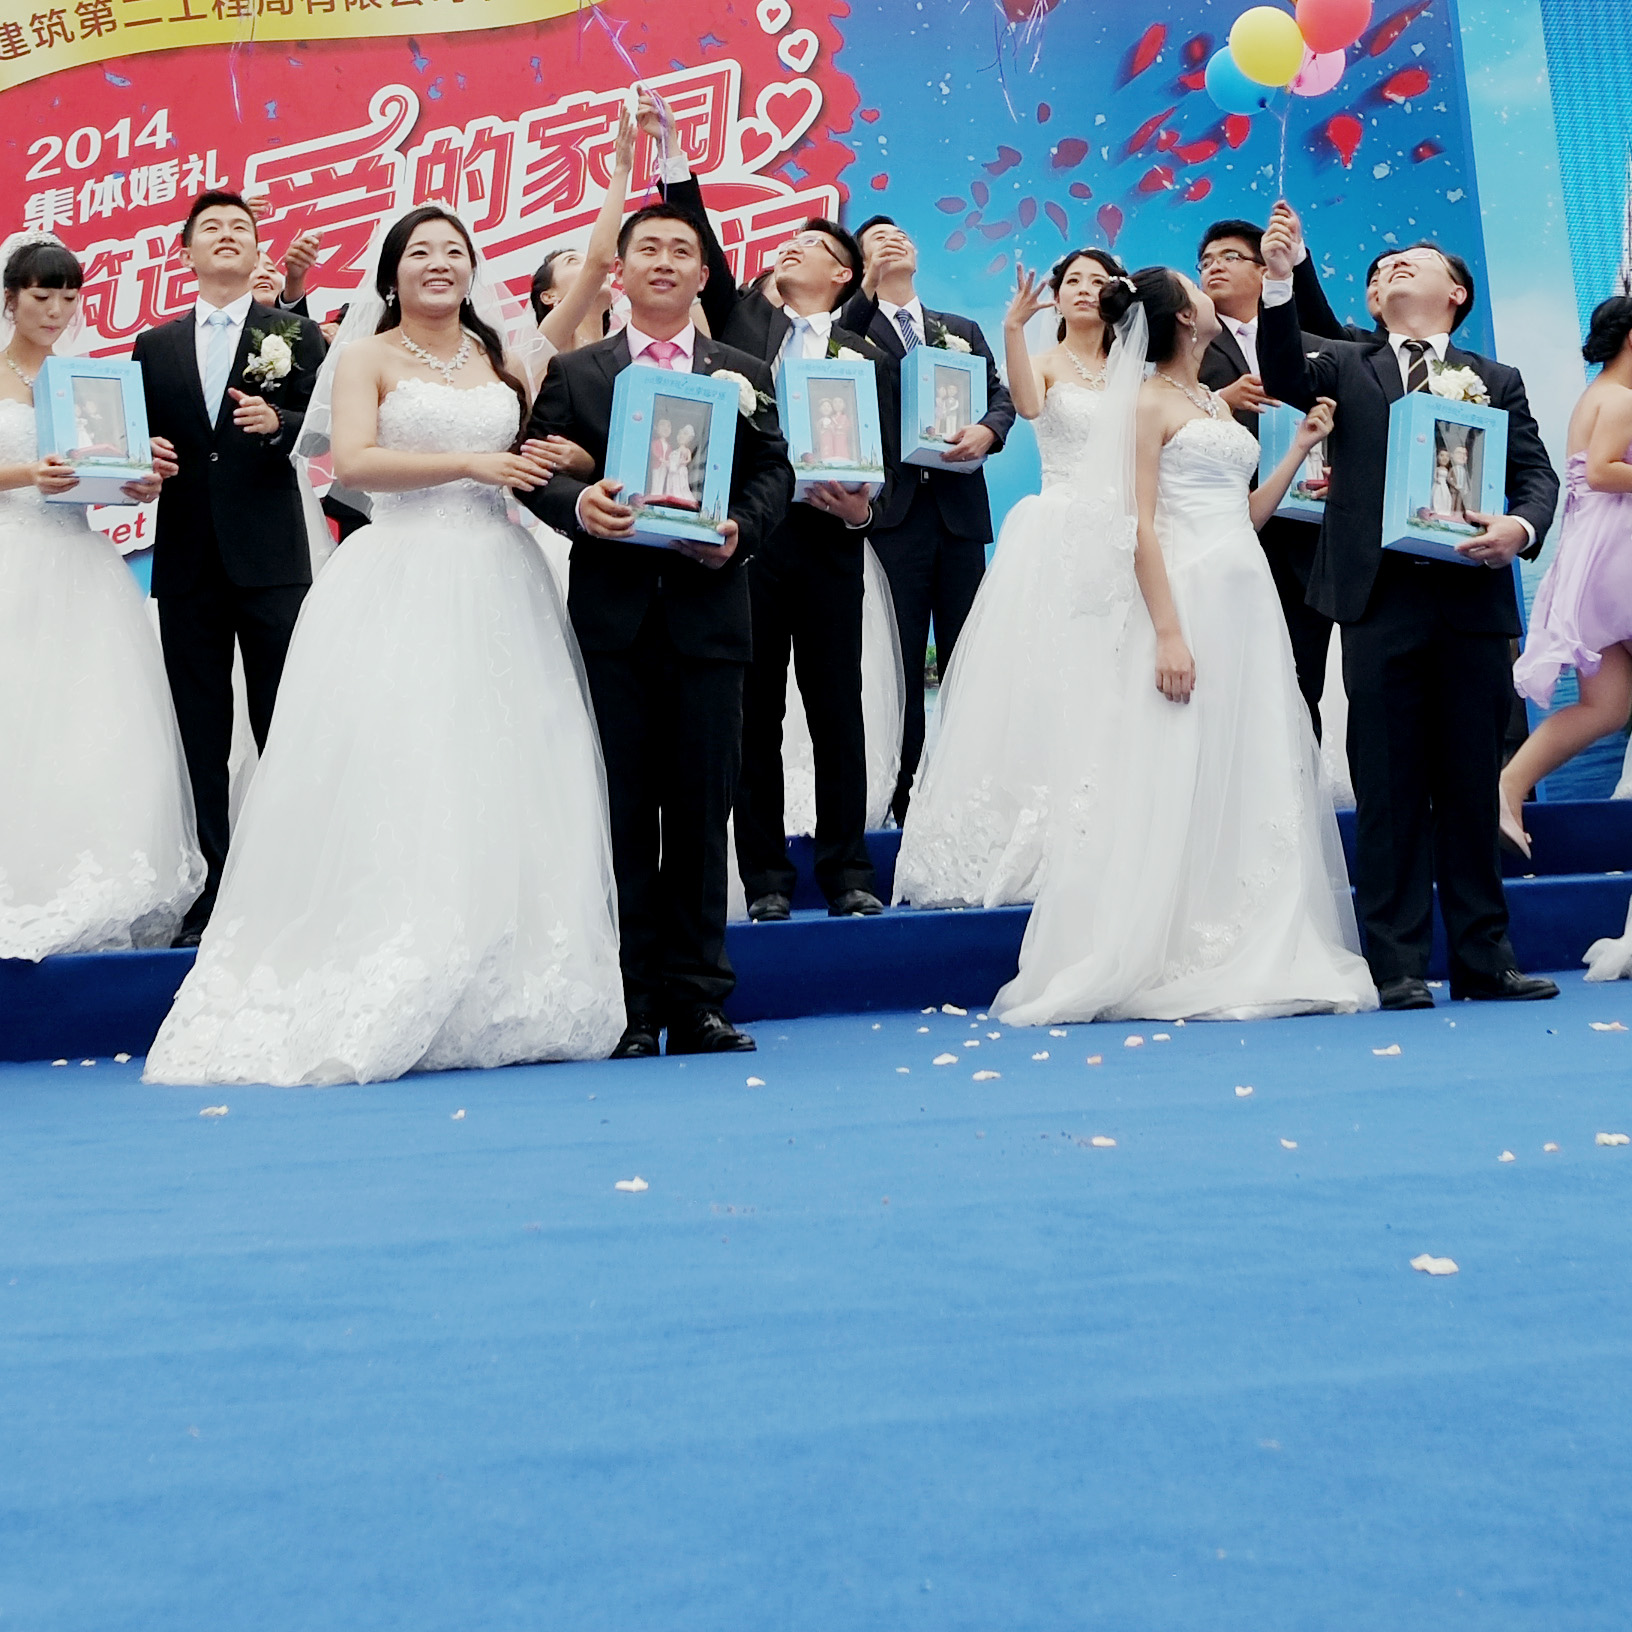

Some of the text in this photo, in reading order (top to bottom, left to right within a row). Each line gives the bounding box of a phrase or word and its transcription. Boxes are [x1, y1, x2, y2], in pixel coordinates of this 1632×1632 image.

[25, 108, 172, 181] 2014
[23, 149, 229, 231] 集体婚礼
